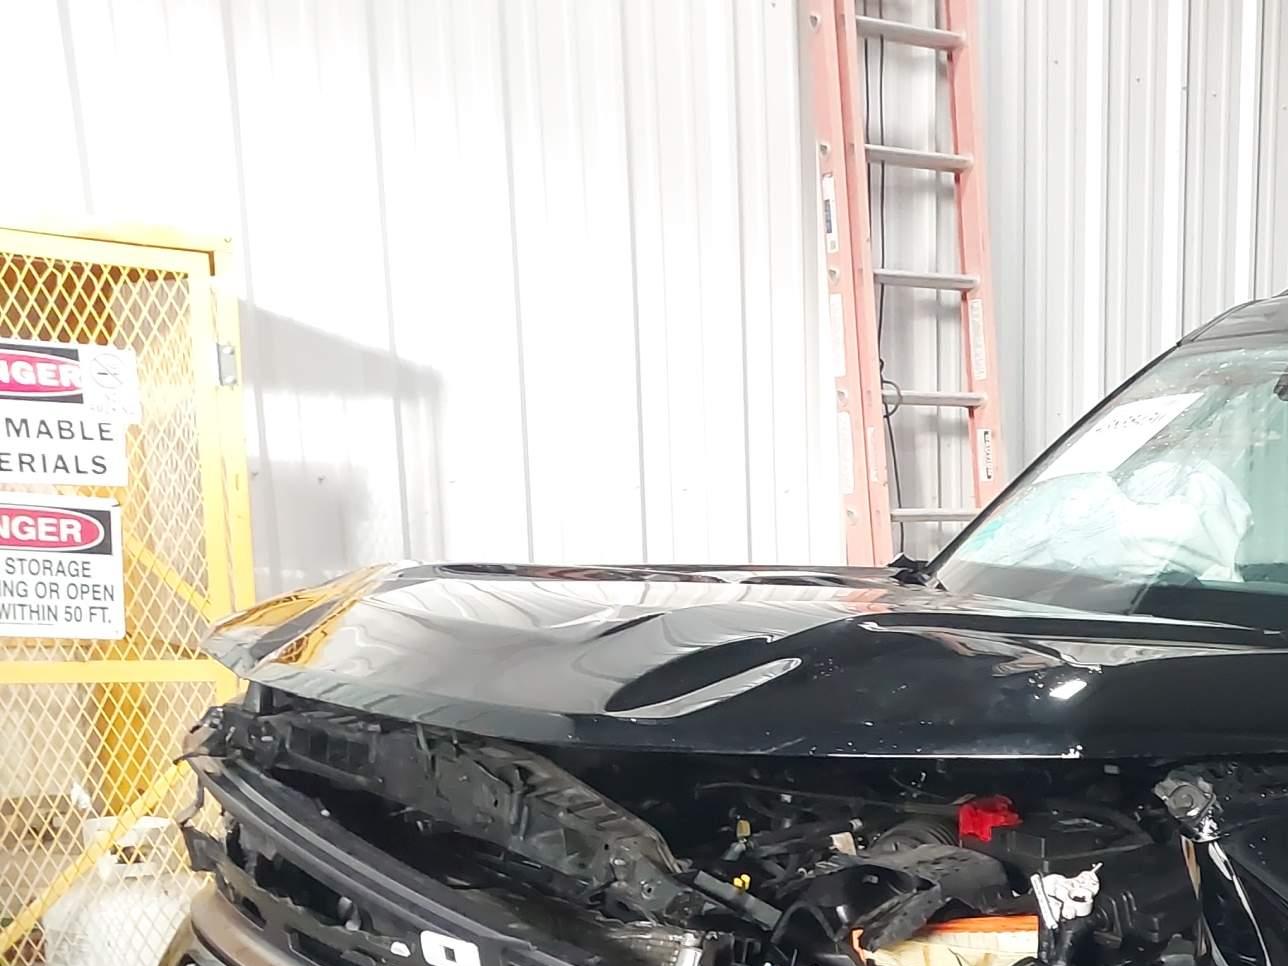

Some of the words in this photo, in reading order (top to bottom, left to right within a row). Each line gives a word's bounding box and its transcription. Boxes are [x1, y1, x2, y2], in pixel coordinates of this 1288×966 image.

[5, 417, 114, 441] MABLE
[0, 452, 107, 475] ERIALS
[5, 556, 92, 578] STORAGE
[35, 581, 60, 600] OR
[67, 583, 114, 602] OPEN
[0, 603, 58, 622] WITHIN
[64, 605, 82, 623] 50
[88, 606, 112, 624] FT.
